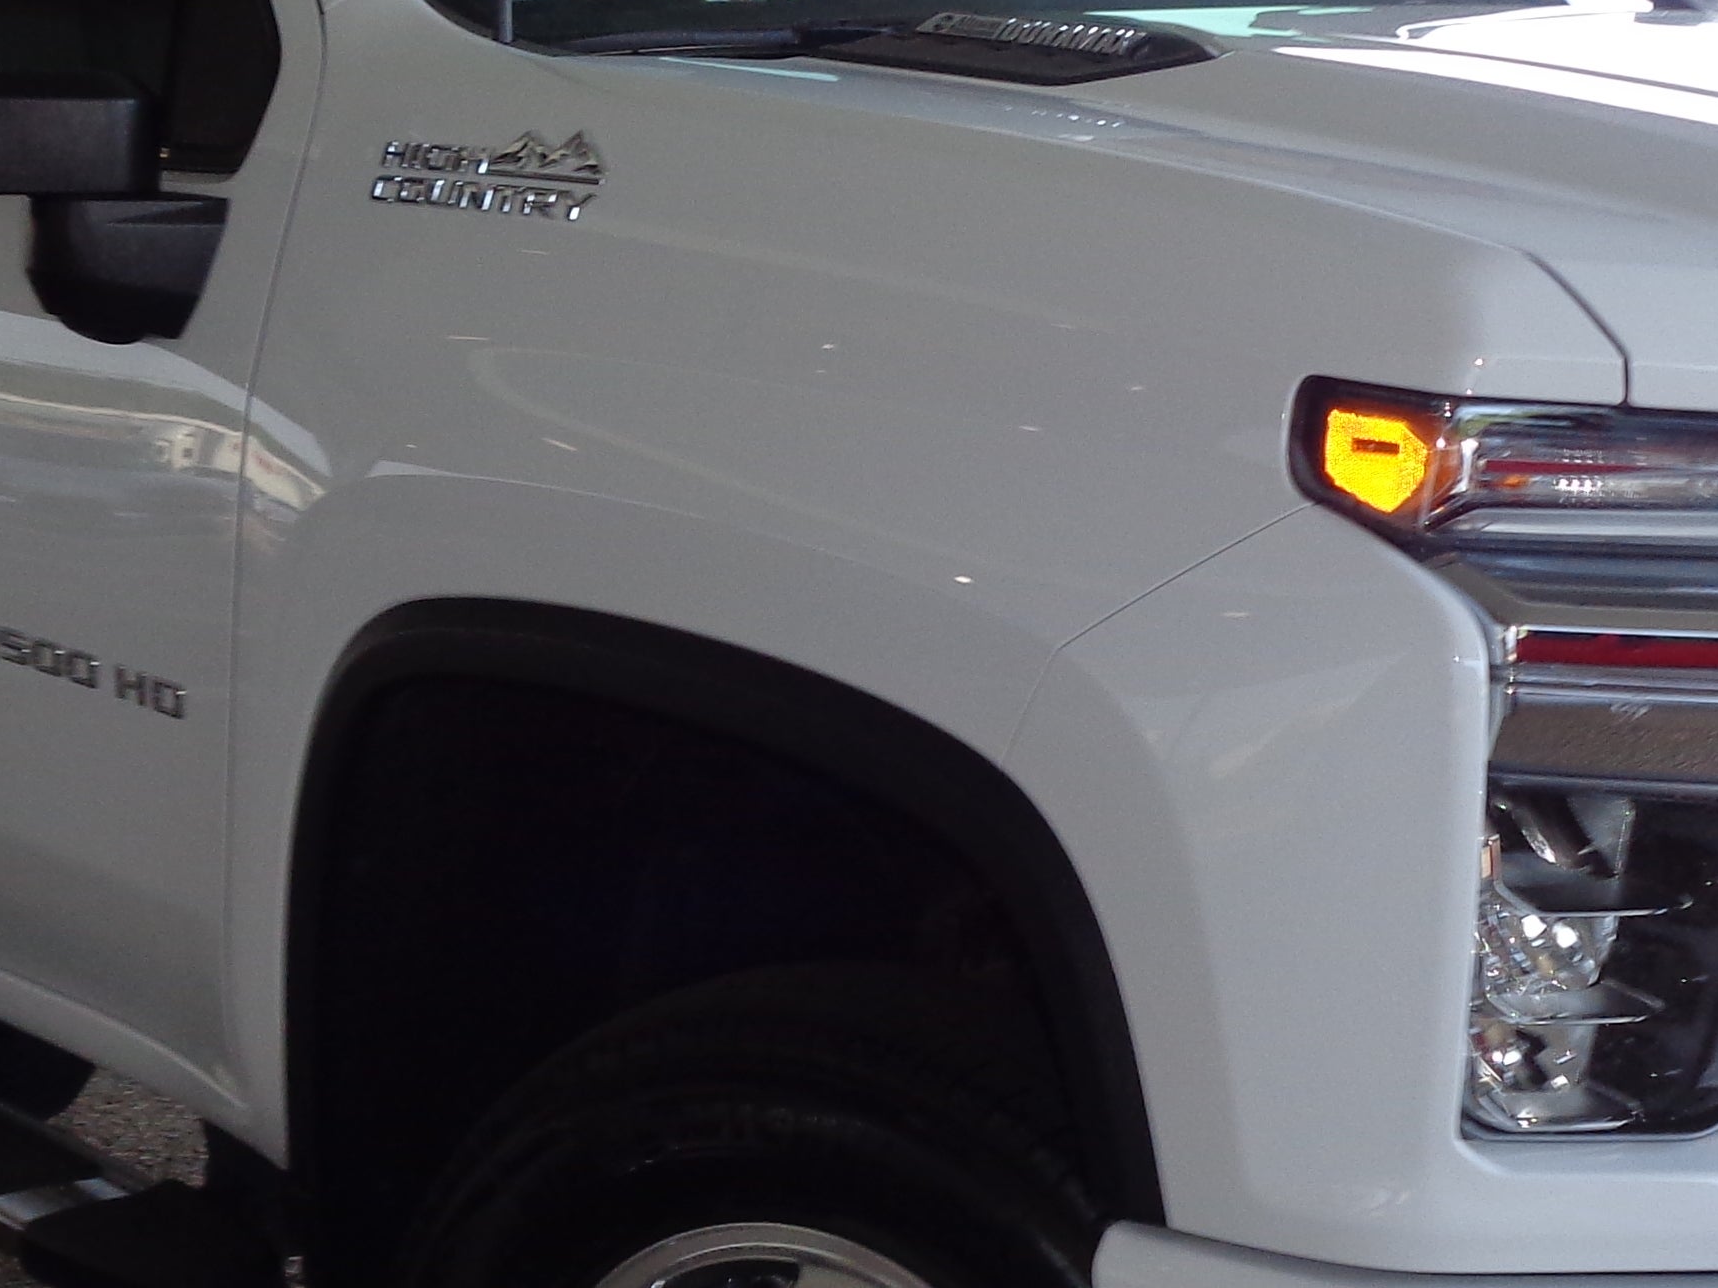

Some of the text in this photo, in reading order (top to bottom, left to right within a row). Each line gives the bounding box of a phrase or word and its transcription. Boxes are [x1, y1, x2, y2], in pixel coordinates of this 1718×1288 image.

[382, 141, 490, 174] HIGH
[372, 176, 596, 221] COUNTRY
[114, 665, 187, 720] HD
